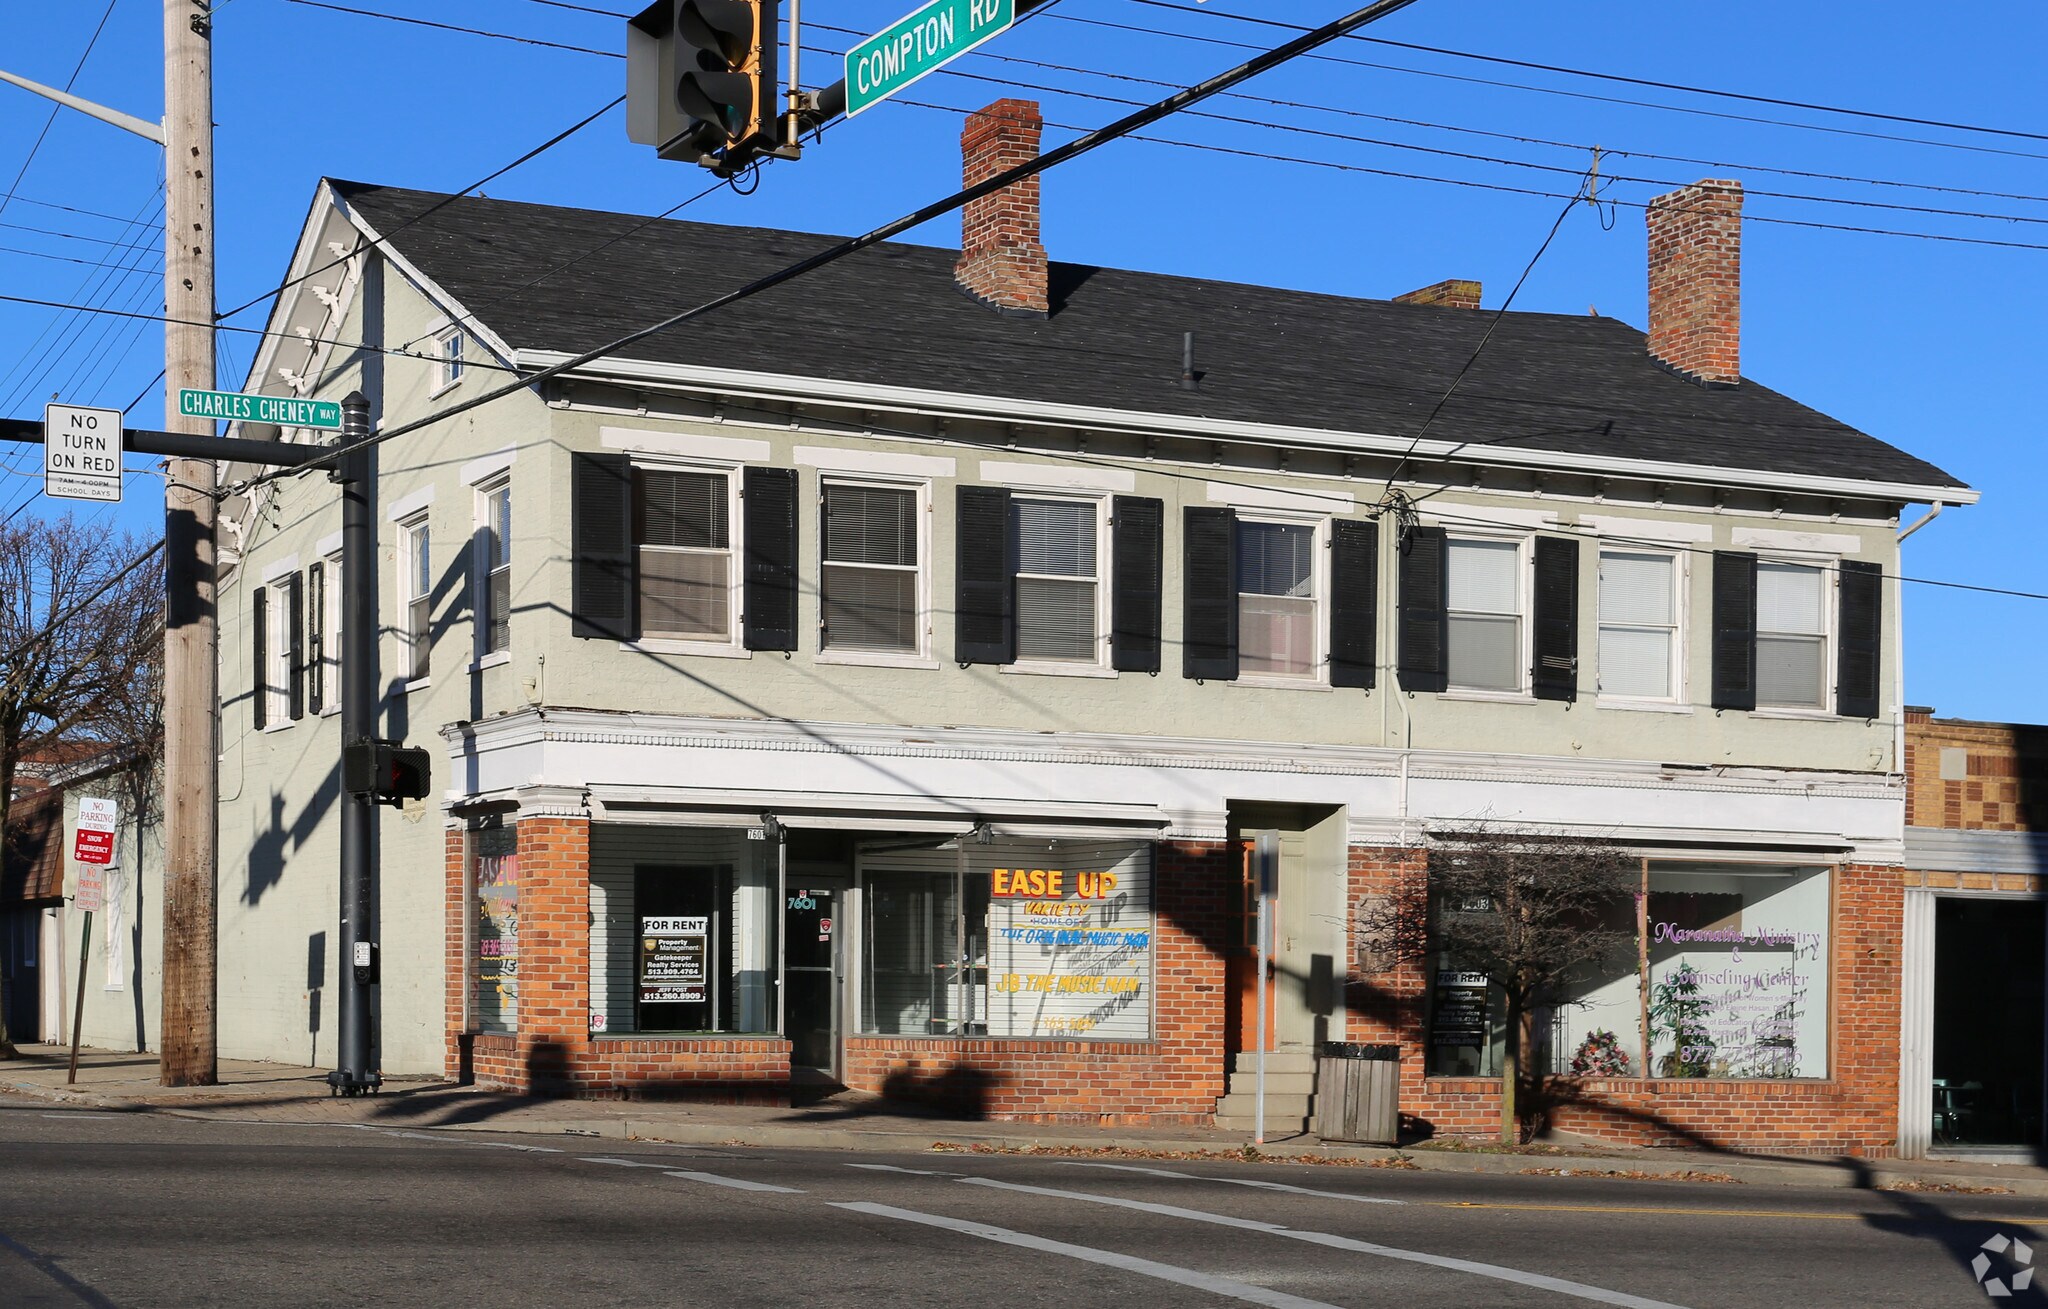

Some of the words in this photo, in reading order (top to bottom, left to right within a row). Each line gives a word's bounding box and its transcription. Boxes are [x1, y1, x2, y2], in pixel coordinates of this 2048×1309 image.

[858, 6, 954, 95] COMPTON
[970, 0, 1000, 32] RD
[184, 392, 250, 418] CHARLES
[260, 400, 316, 423] CHENEY
[320, 408, 336, 421] WAY
[71, 414, 98, 430] NO
[62, 434, 106, 451] TURN
[52, 453, 74, 469] ON
[83, 455, 115, 472] RED
[57, 486, 88, 495] SCHOOL
[91, 489, 111, 497] DAYS
[92, 802, 104, 811] NO
[80, 811, 114, 824] PARKING
[85, 822, 107, 830] DURING
[87, 868, 97, 878] NO
[991, 868, 1063, 898] EASE
[1075, 871, 1118, 899] UP
[787, 897, 817, 910] 7601
[1023, 901, 1091, 917] VARIETY
[645, 920, 669, 930] FOR
[672, 920, 704, 930] RENT
[1032, 917, 1062, 926] HOME
[1025, 928, 1086, 946] ORIGINAL
[1085, 930, 1121, 948] MUSIC
[1121, 931, 1150, 949] MAN
[1654, 922, 1747, 945] Maranatha
[1749, 925, 1820, 947] Ministry
[658, 939, 688, 947] Property
[654, 954, 693, 962] Gatekeeper
[1731, 946, 1743, 963] &
[646, 961, 669, 969] Realty
[995, 973, 1021, 993] JB
[1026, 973, 1057, 993] THE
[1057, 974, 1102, 994] MUSIC
[1103, 975, 1140, 995] MAN
[1438, 974, 1457, 983] FOR
[1460, 972, 1486, 983] RENT
[1664, 968, 1756, 993] Counseling
[643, 992, 701, 1000] 513.260.8909
